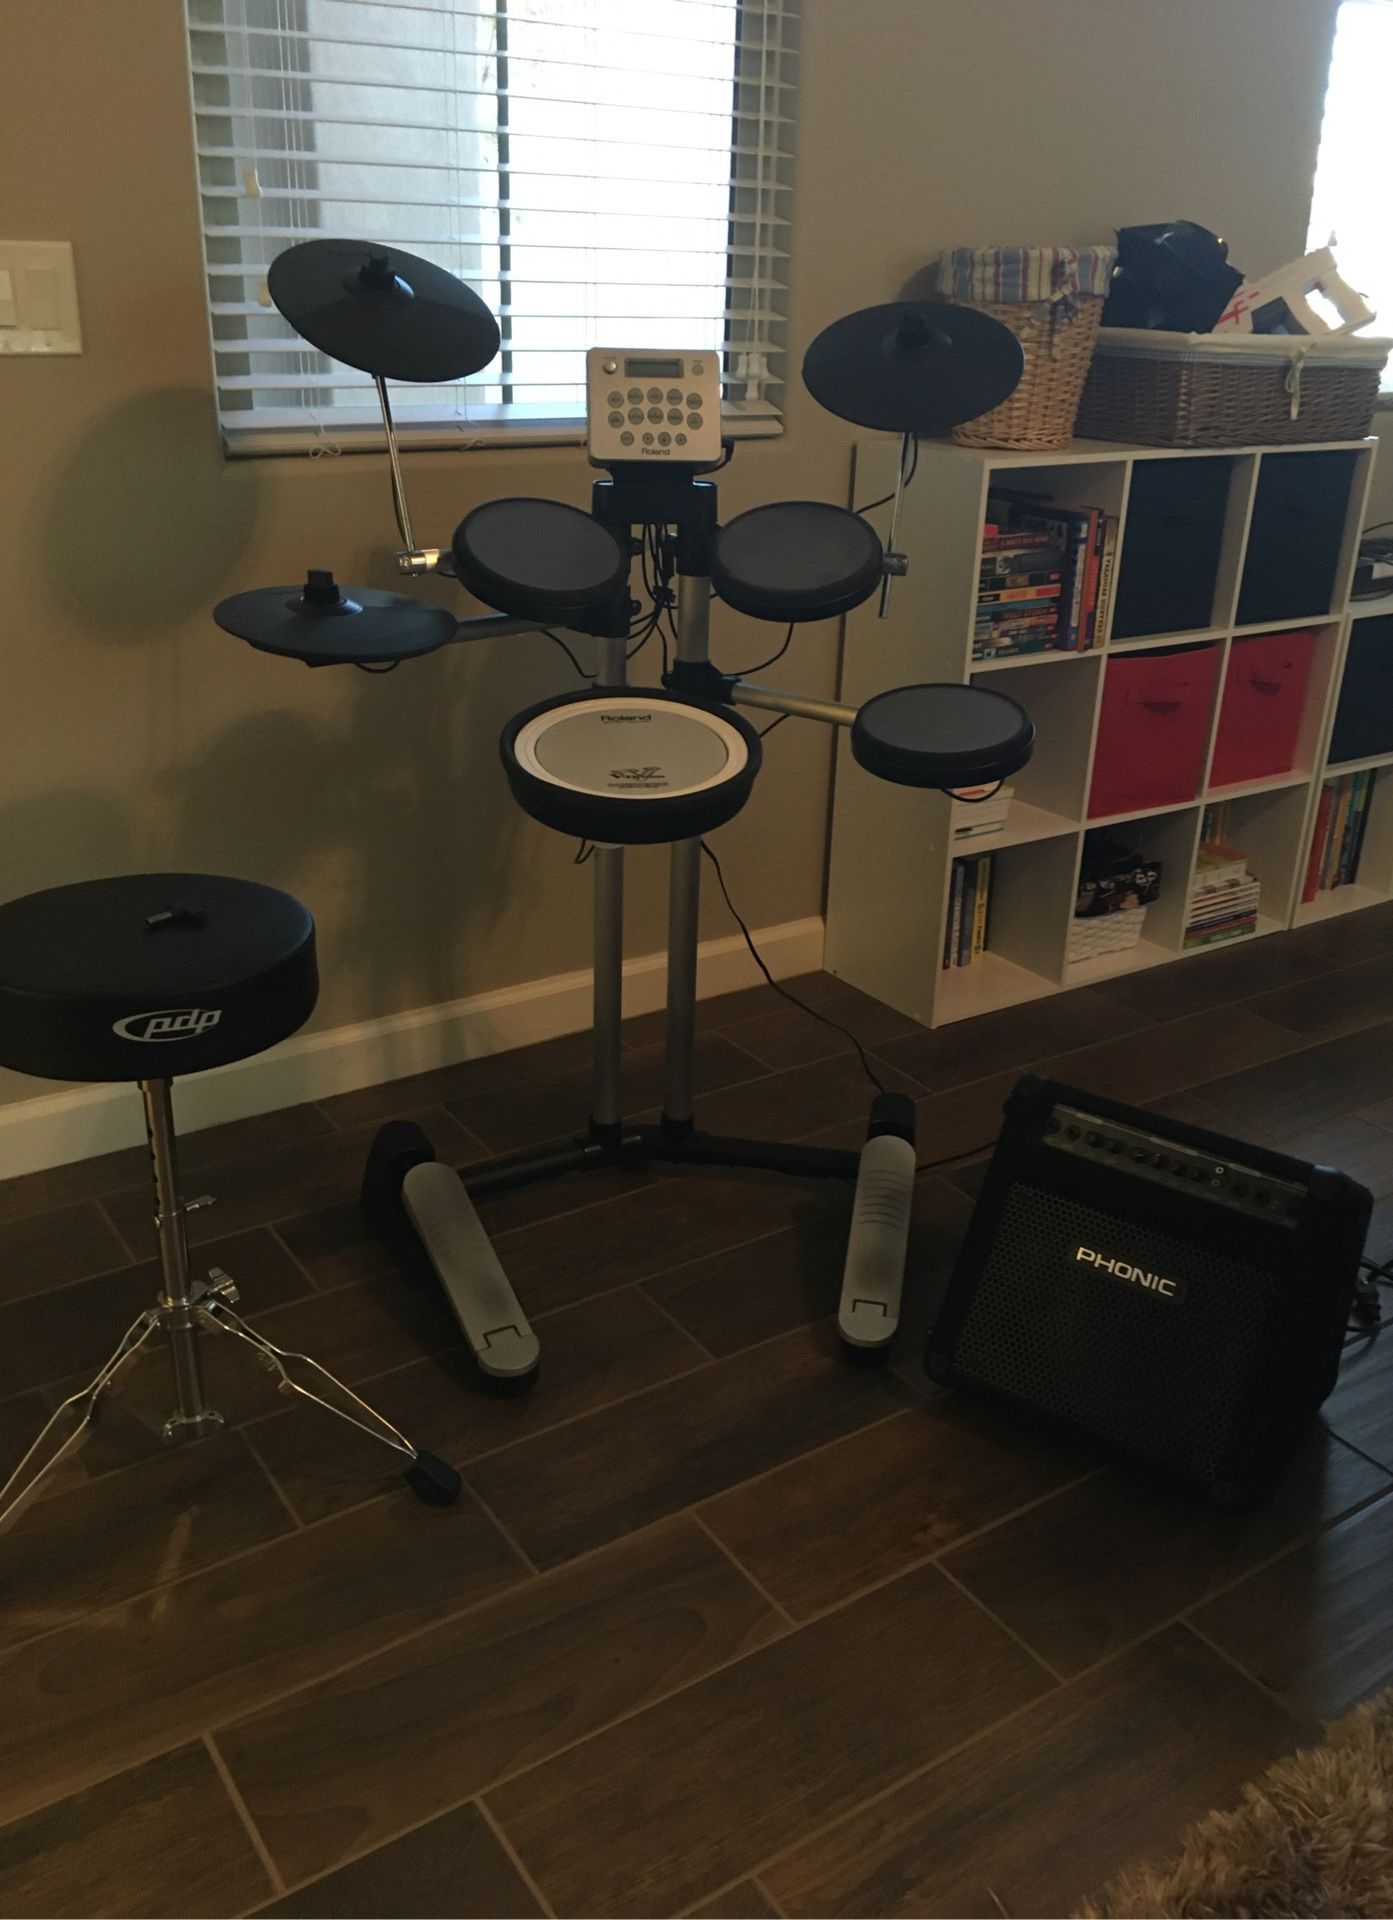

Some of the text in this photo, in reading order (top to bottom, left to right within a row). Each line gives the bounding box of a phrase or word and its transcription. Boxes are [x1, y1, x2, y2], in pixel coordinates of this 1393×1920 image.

[641, 447, 671, 456] Roland
[600, 714, 652, 722] Roland
[142, 1008, 223, 1040] pdp
[1075, 1246, 1177, 1297] PHONIC
